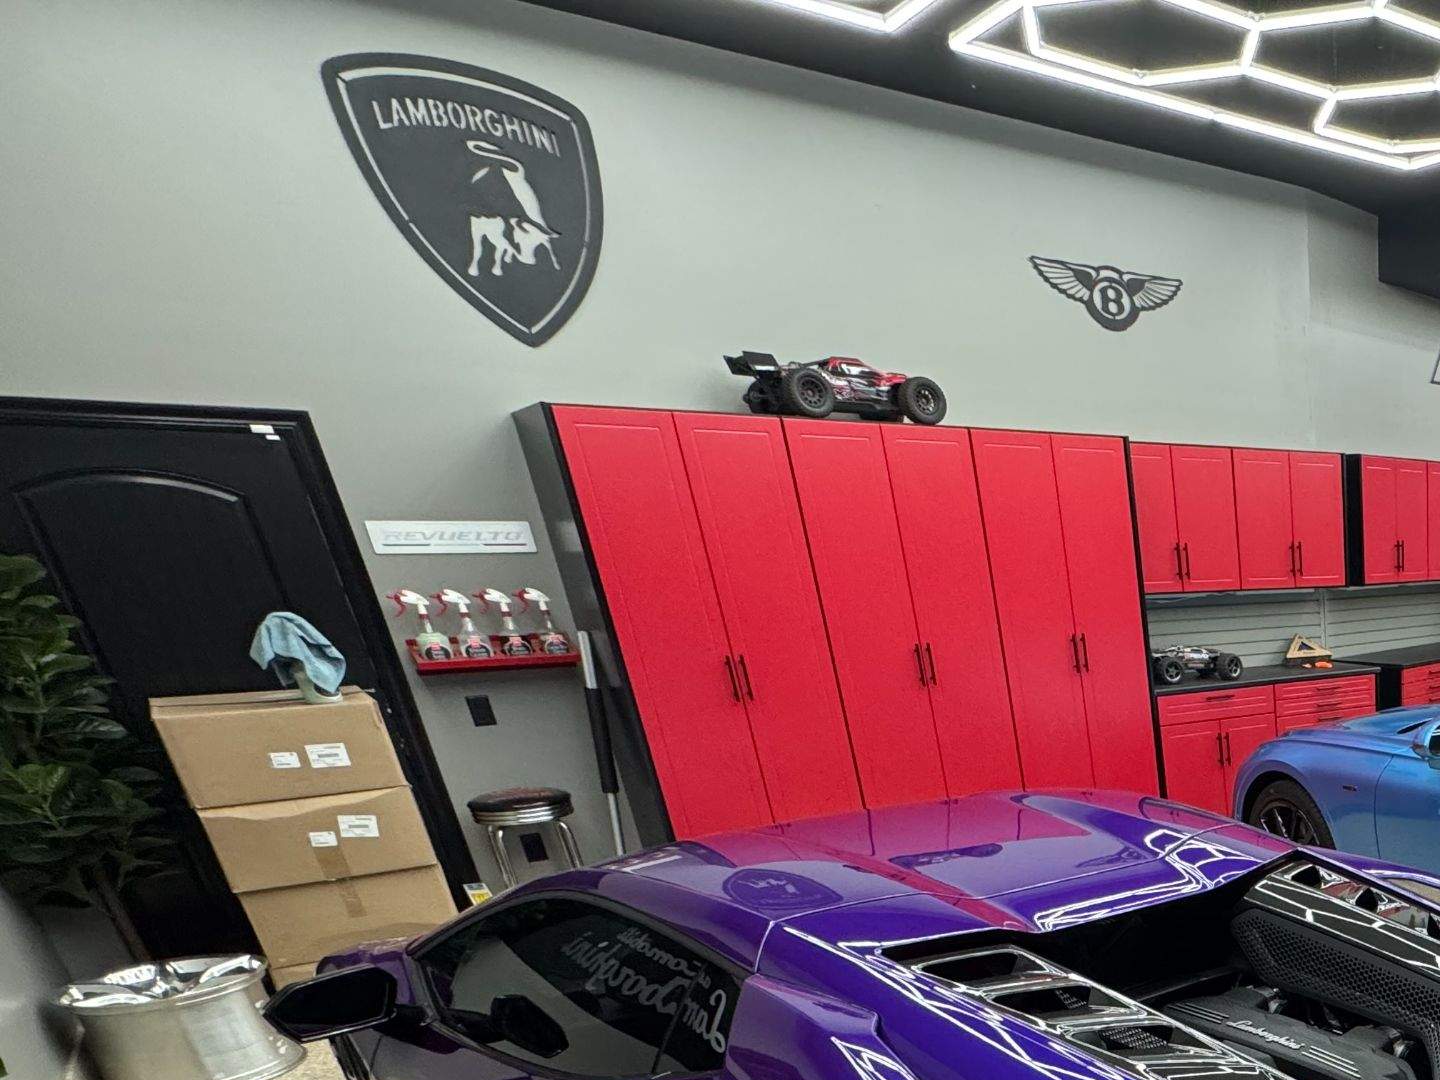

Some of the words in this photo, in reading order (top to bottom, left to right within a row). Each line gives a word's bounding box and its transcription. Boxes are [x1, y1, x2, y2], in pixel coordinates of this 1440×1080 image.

[372, 97, 561, 158] LAMBORGHINI
[1099, 284, 1125, 317] B
[383, 530, 524, 542] REVUELTO
